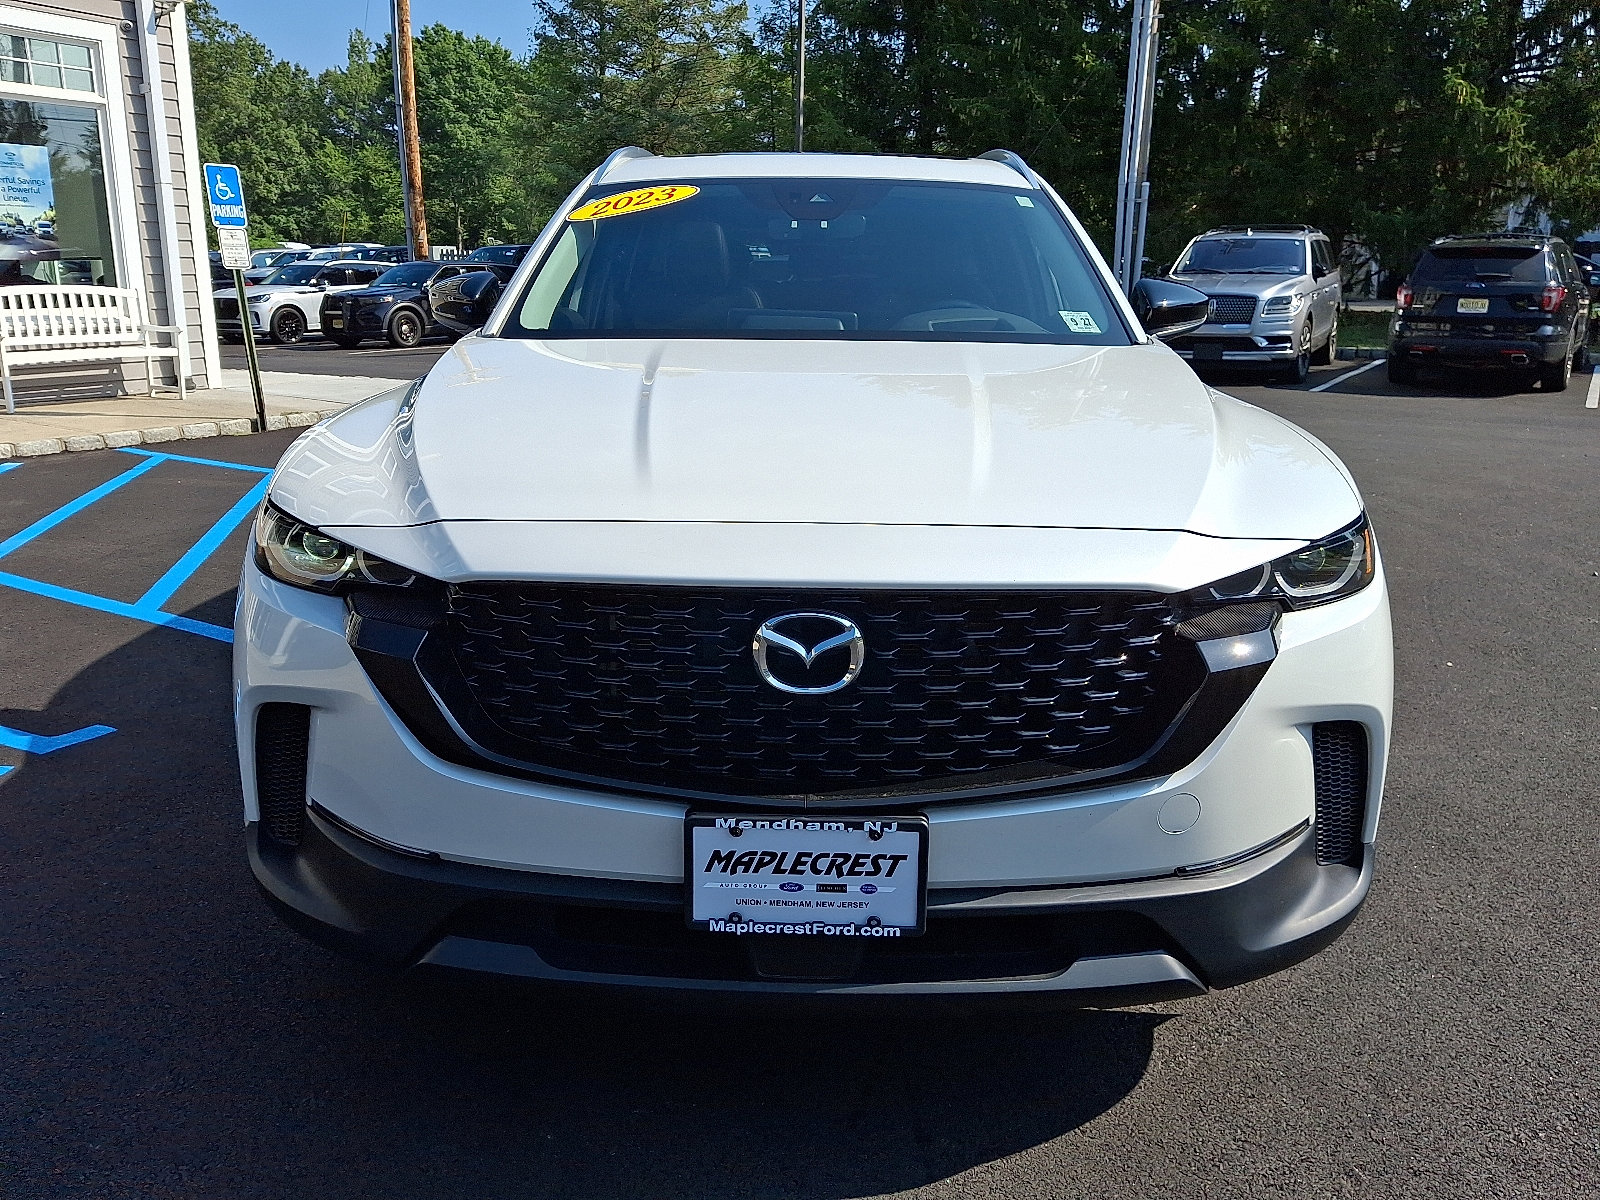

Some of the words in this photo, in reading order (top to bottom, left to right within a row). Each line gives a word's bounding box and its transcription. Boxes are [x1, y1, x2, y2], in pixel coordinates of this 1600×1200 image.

[17, 177, 46, 187] Savings
[8, 186, 41, 195] Powerful
[589, 187, 678, 217] 2023
[212, 203, 244, 218] PARKING
[1070, 318, 1078, 326] 9
[715, 818, 853, 833] Mendham,
[863, 821, 898, 834] NJ
[703, 849, 909, 879] MAPLECREST
[735, 898, 761, 906] UNION
[769, 899, 814, 908] MENDHAM,
[837, 901, 870, 909] JERSEY
[709, 919, 901, 937] MaplecrestFord.com
